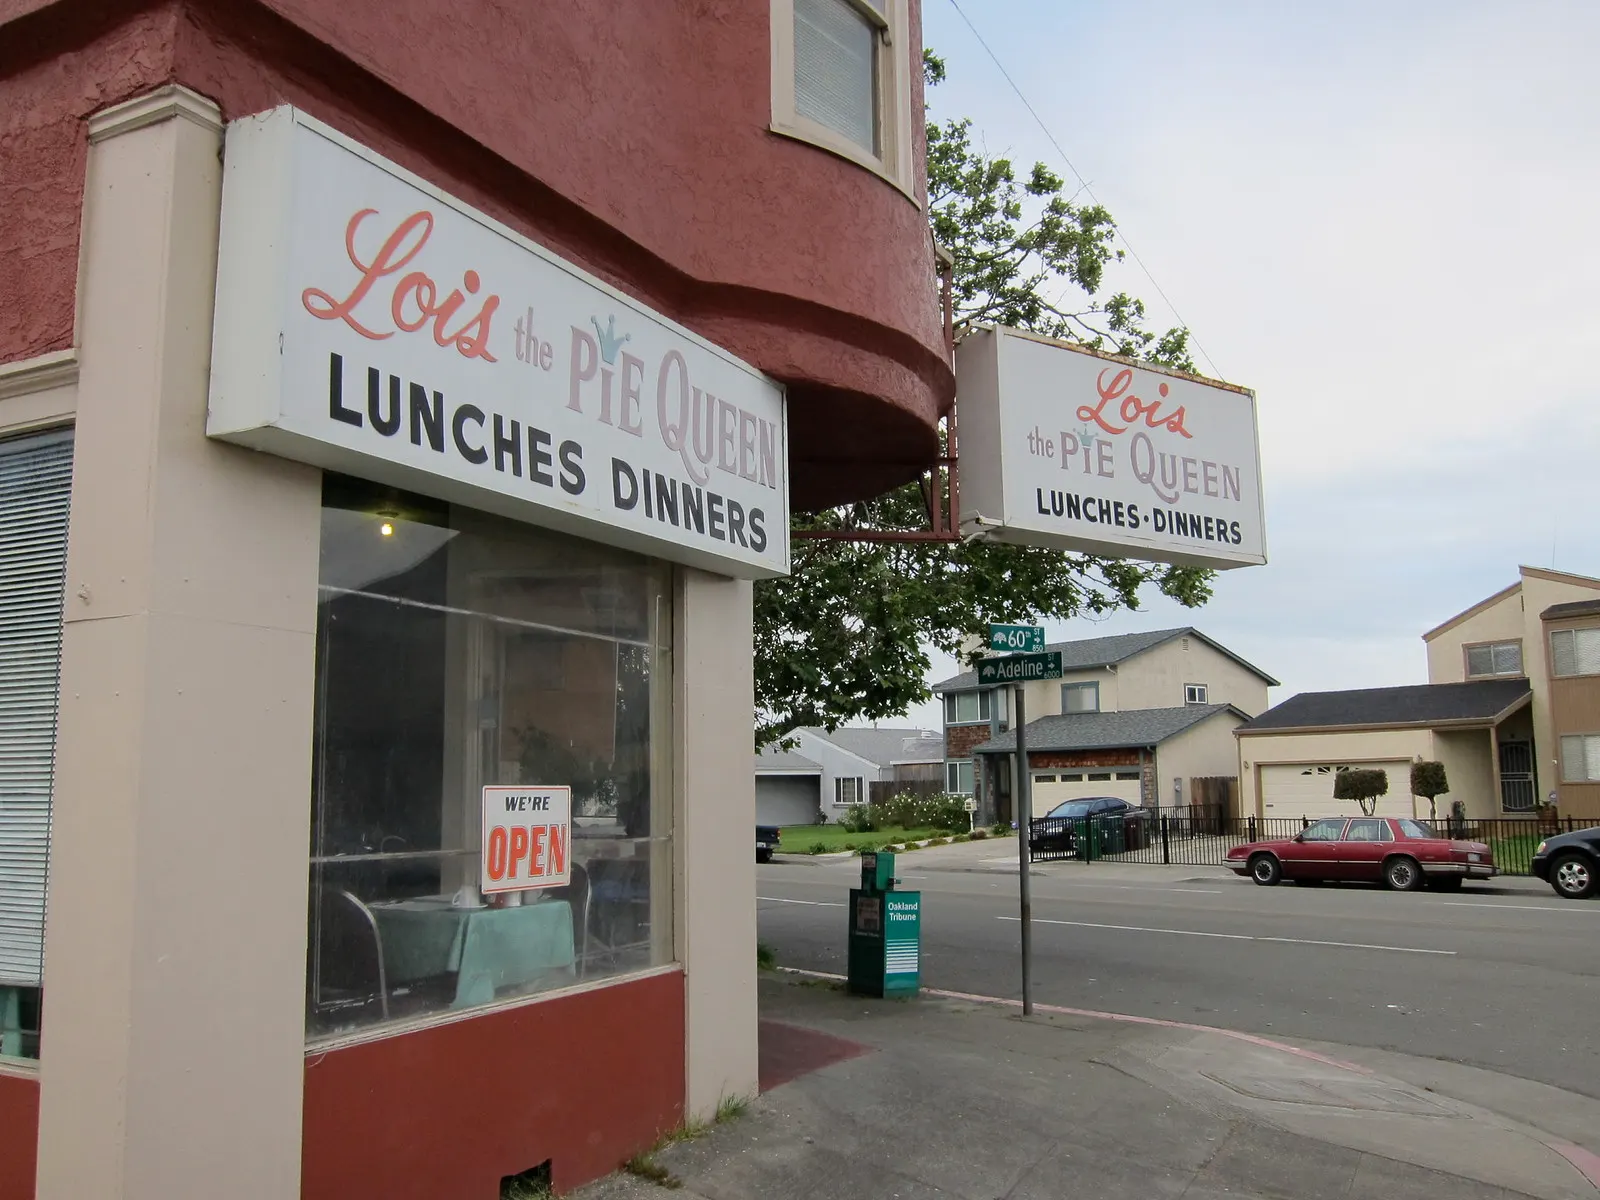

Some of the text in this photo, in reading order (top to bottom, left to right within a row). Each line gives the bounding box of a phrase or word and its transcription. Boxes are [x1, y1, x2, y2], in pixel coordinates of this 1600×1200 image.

[302, 208, 500, 363] Lois
[513, 306, 553, 371] the
[1076, 367, 1193, 439] Lois
[329, 352, 769, 553] LUNCHES DINNERS
[1027, 426, 1055, 458] the
[996, 660, 1043, 679] Adeline
[505, 796, 551, 812] WE'RE
[487, 823, 567, 882] OPEN
[888, 902, 918, 911] Oakland
[889, 912, 917, 921] Tribune
